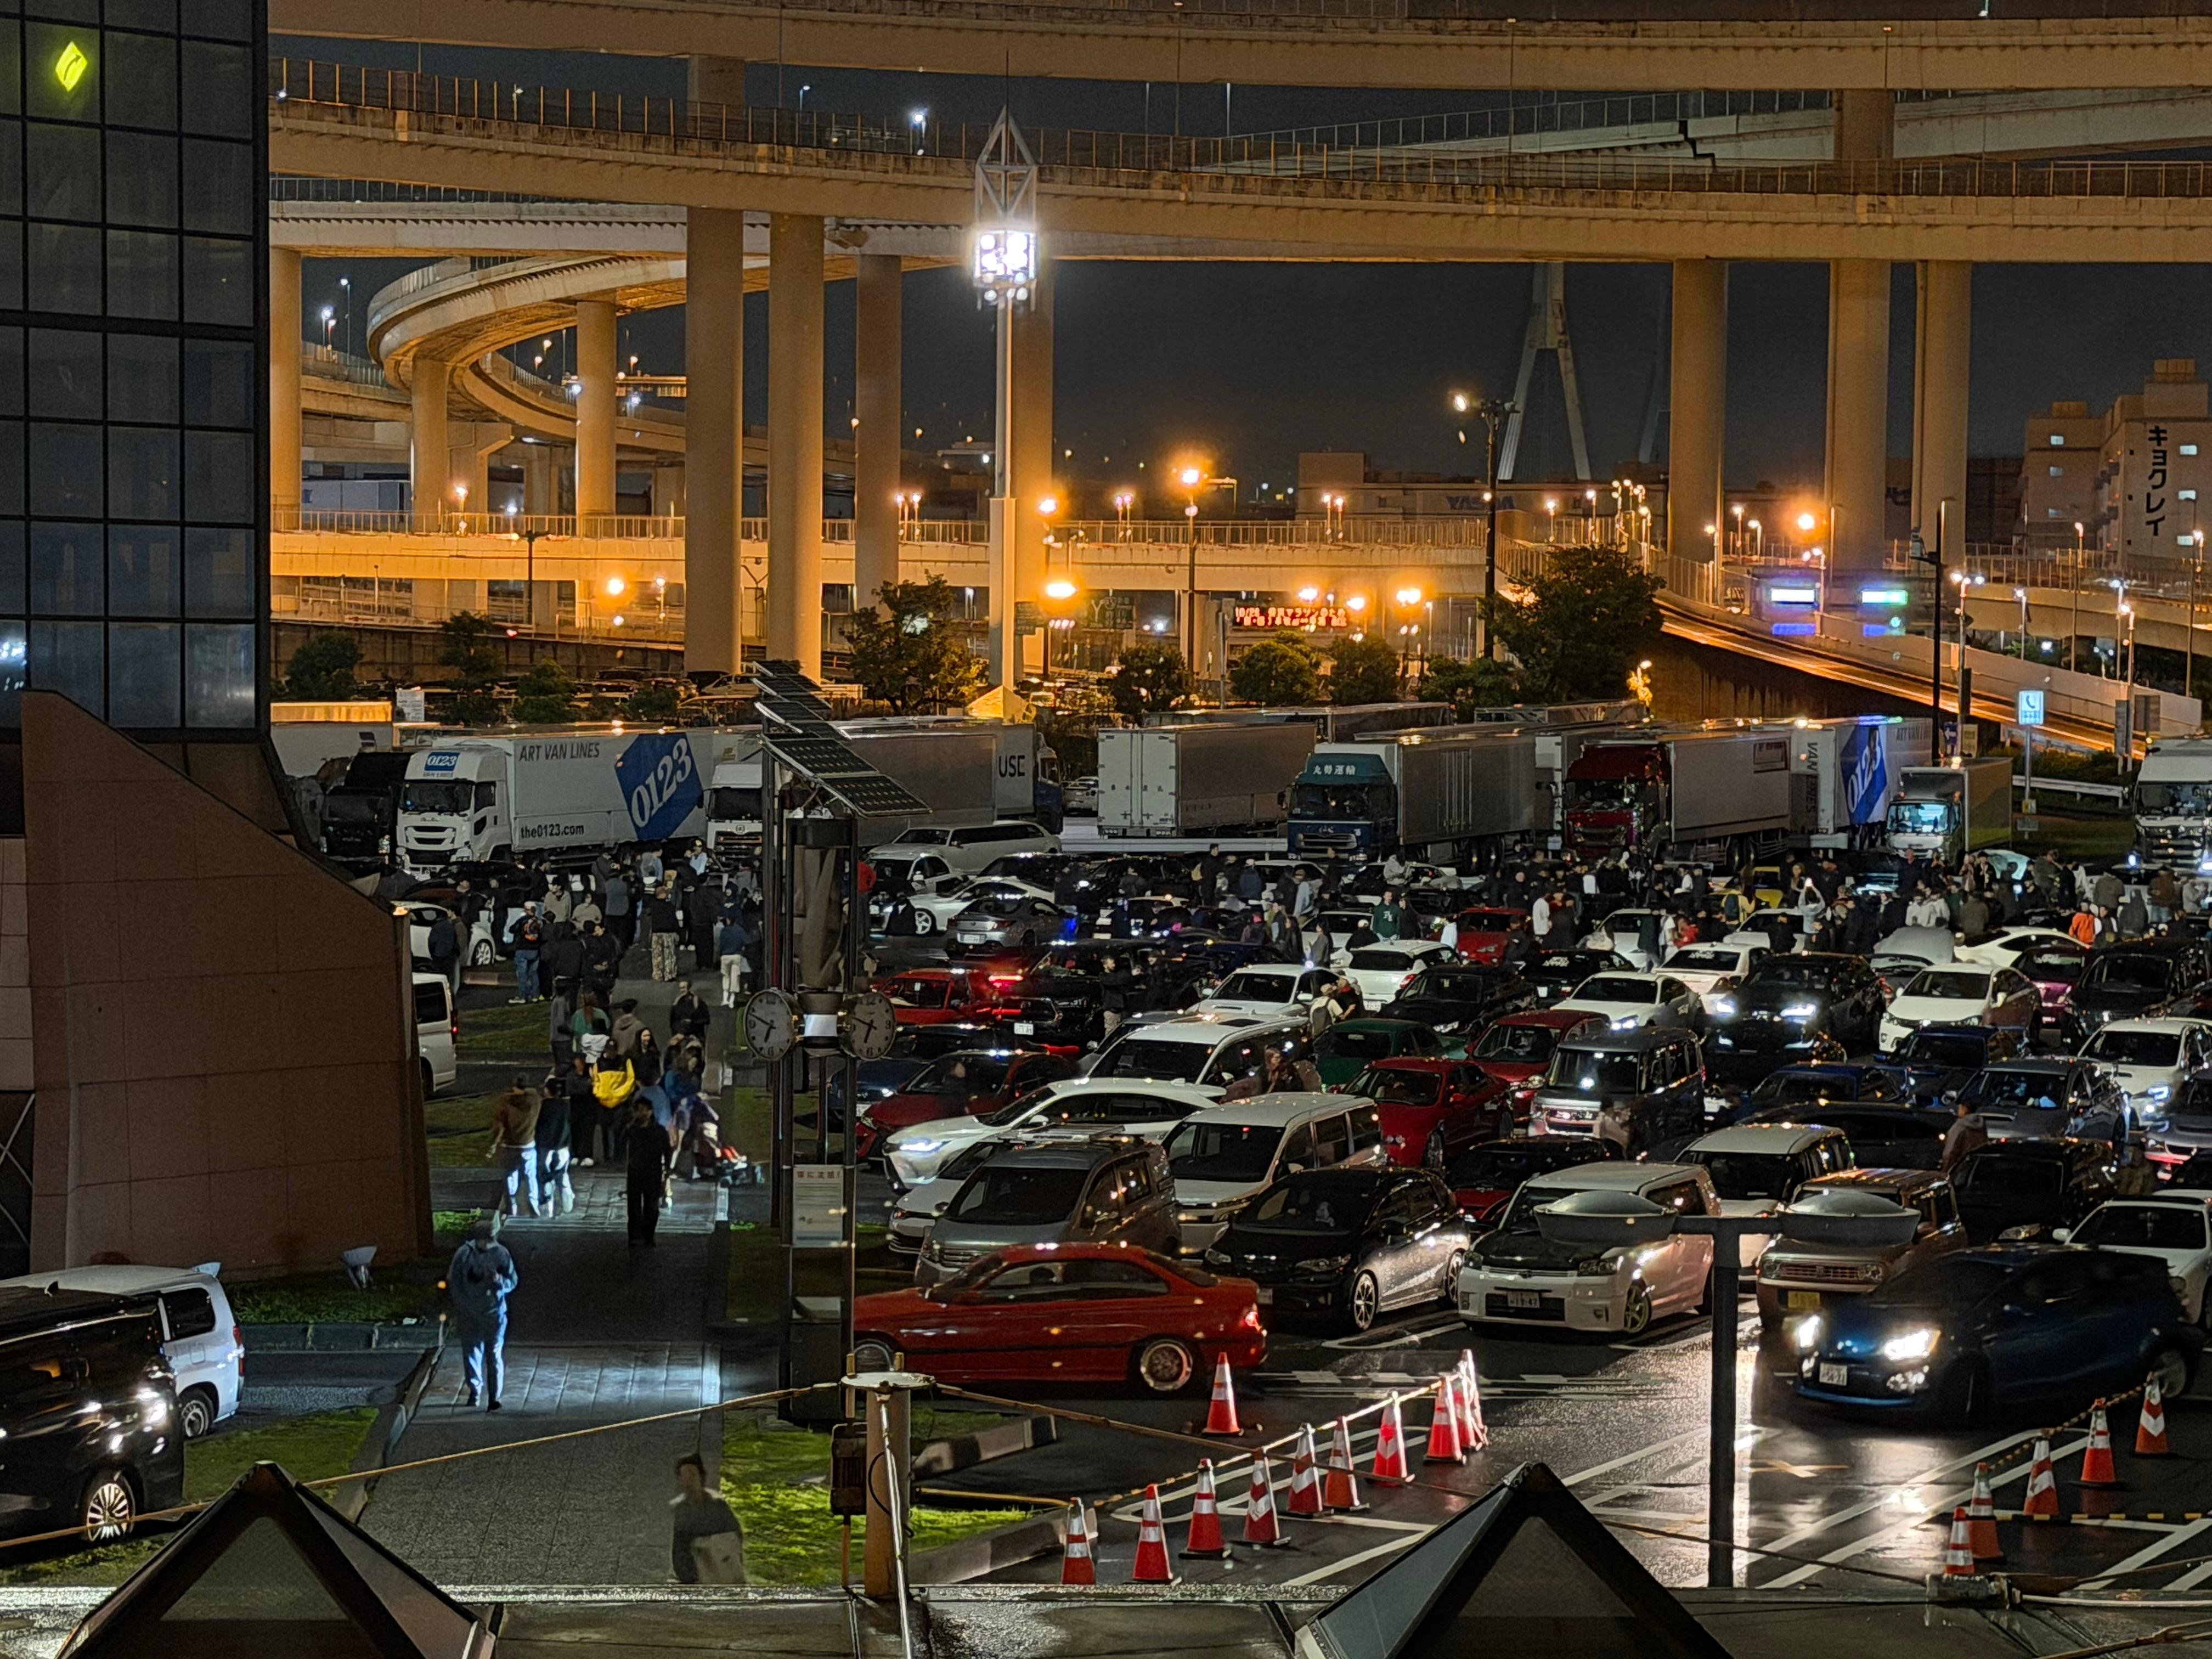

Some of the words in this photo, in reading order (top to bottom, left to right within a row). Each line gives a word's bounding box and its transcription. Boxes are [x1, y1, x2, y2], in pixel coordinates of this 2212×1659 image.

[2146, 425, 2168, 537] キョクレイ
[427, 755, 457, 766] 0123
[518, 744, 542, 762] ART
[544, 743, 567, 760] VAN
[569, 742, 601, 759] LINES
[1807, 742, 1819, 772] VAN
[631, 738, 692, 828] 0123
[520, 823, 585, 839] the0123.com
